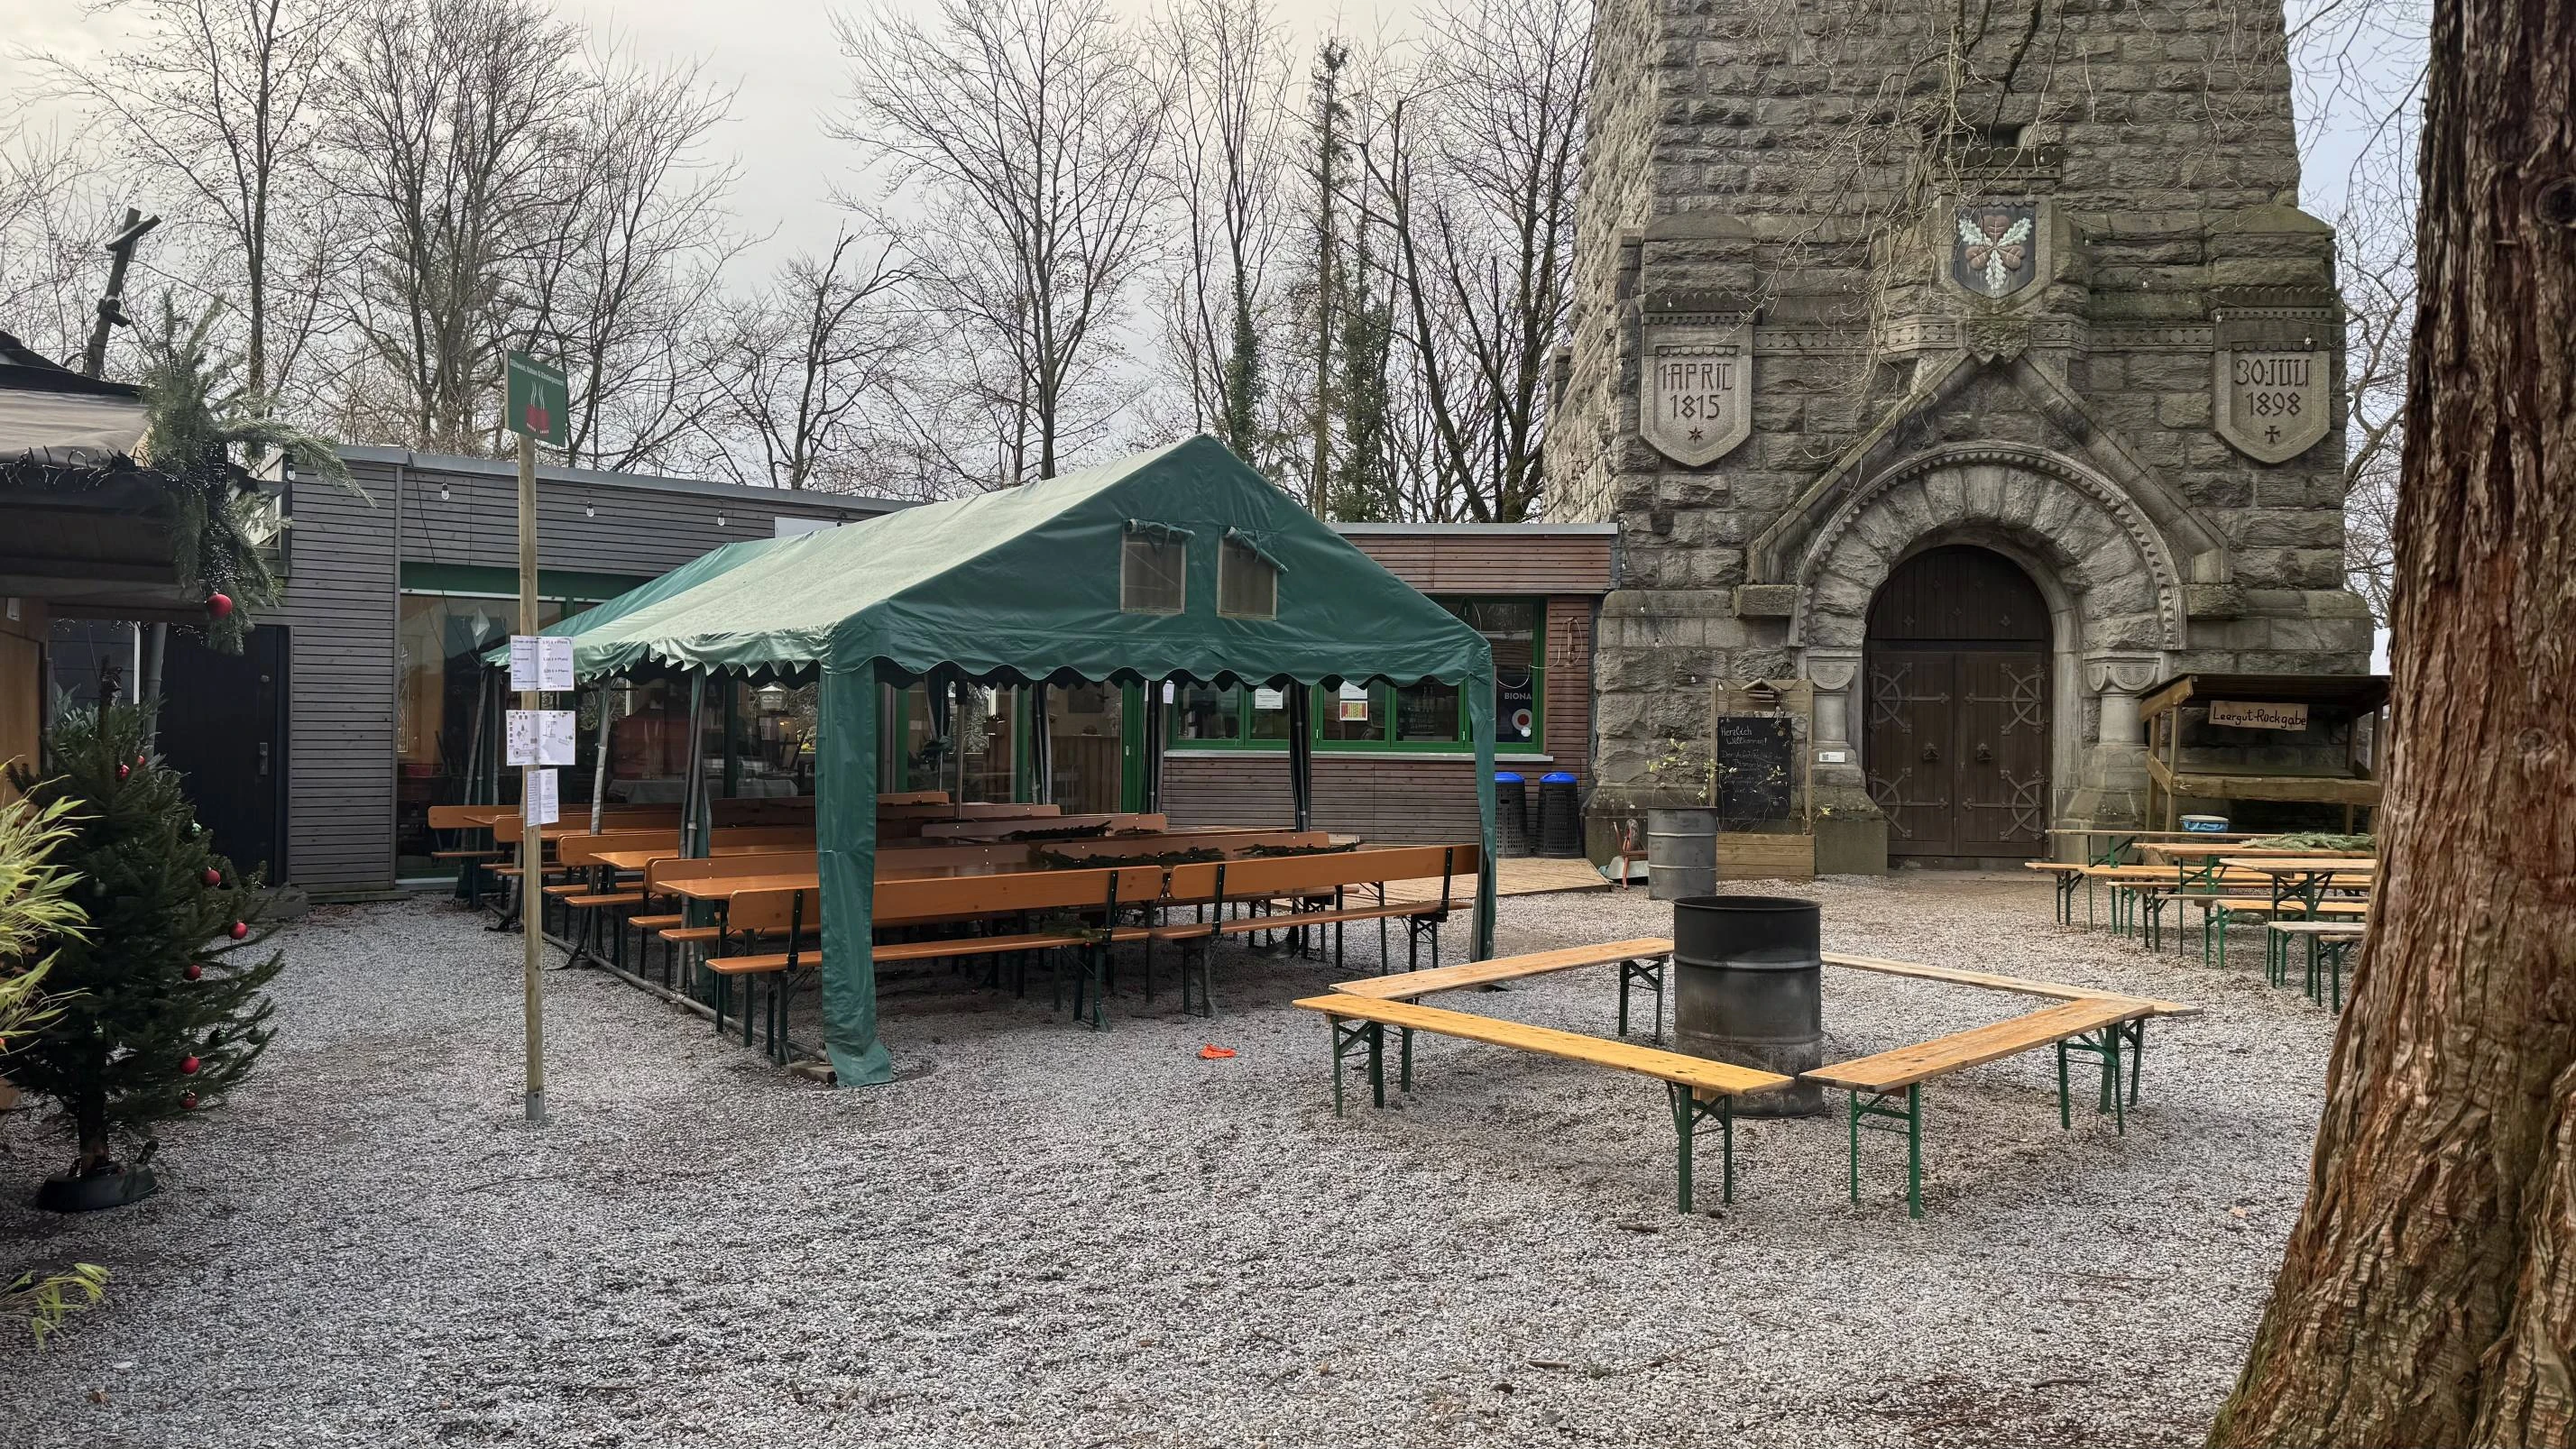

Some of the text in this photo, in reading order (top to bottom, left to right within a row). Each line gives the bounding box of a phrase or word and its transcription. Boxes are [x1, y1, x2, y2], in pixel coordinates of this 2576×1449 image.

[1670, 394, 1721, 420] 1815
[2245, 391, 2302, 417] 1898
[1721, 725, 1753, 737] Herzlich
